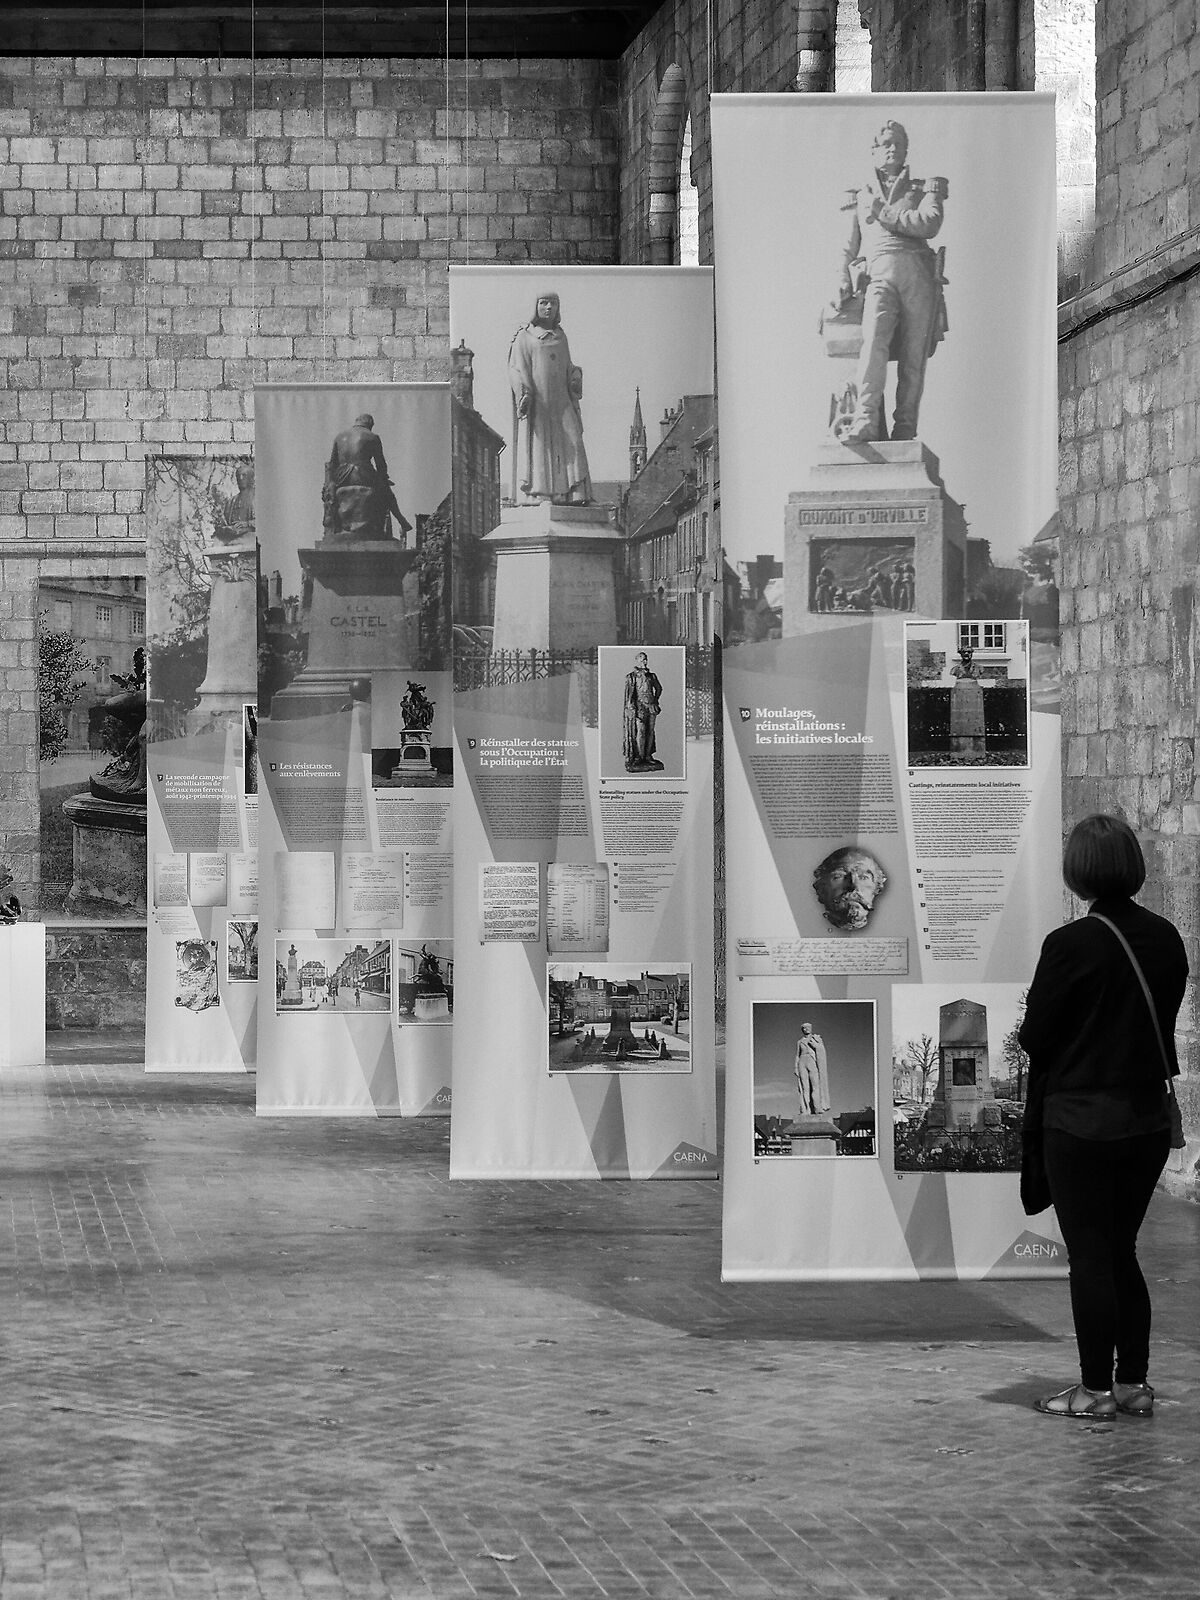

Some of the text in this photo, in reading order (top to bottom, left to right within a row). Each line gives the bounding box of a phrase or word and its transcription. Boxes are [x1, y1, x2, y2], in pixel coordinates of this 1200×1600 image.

[331, 616, 387, 627] CASTEL
[741, 710, 750, 718] 10
[755, 707, 816, 721] Moulages,
[755, 721, 840, 731] réinstallations
[480, 738, 530, 746] Réinstaller
[531, 738, 546, 746] des
[755, 733, 874, 744] les initiatives locales
[501, 748, 559, 758] l'Occupation
[480, 757, 568, 768] la politique de l'État
